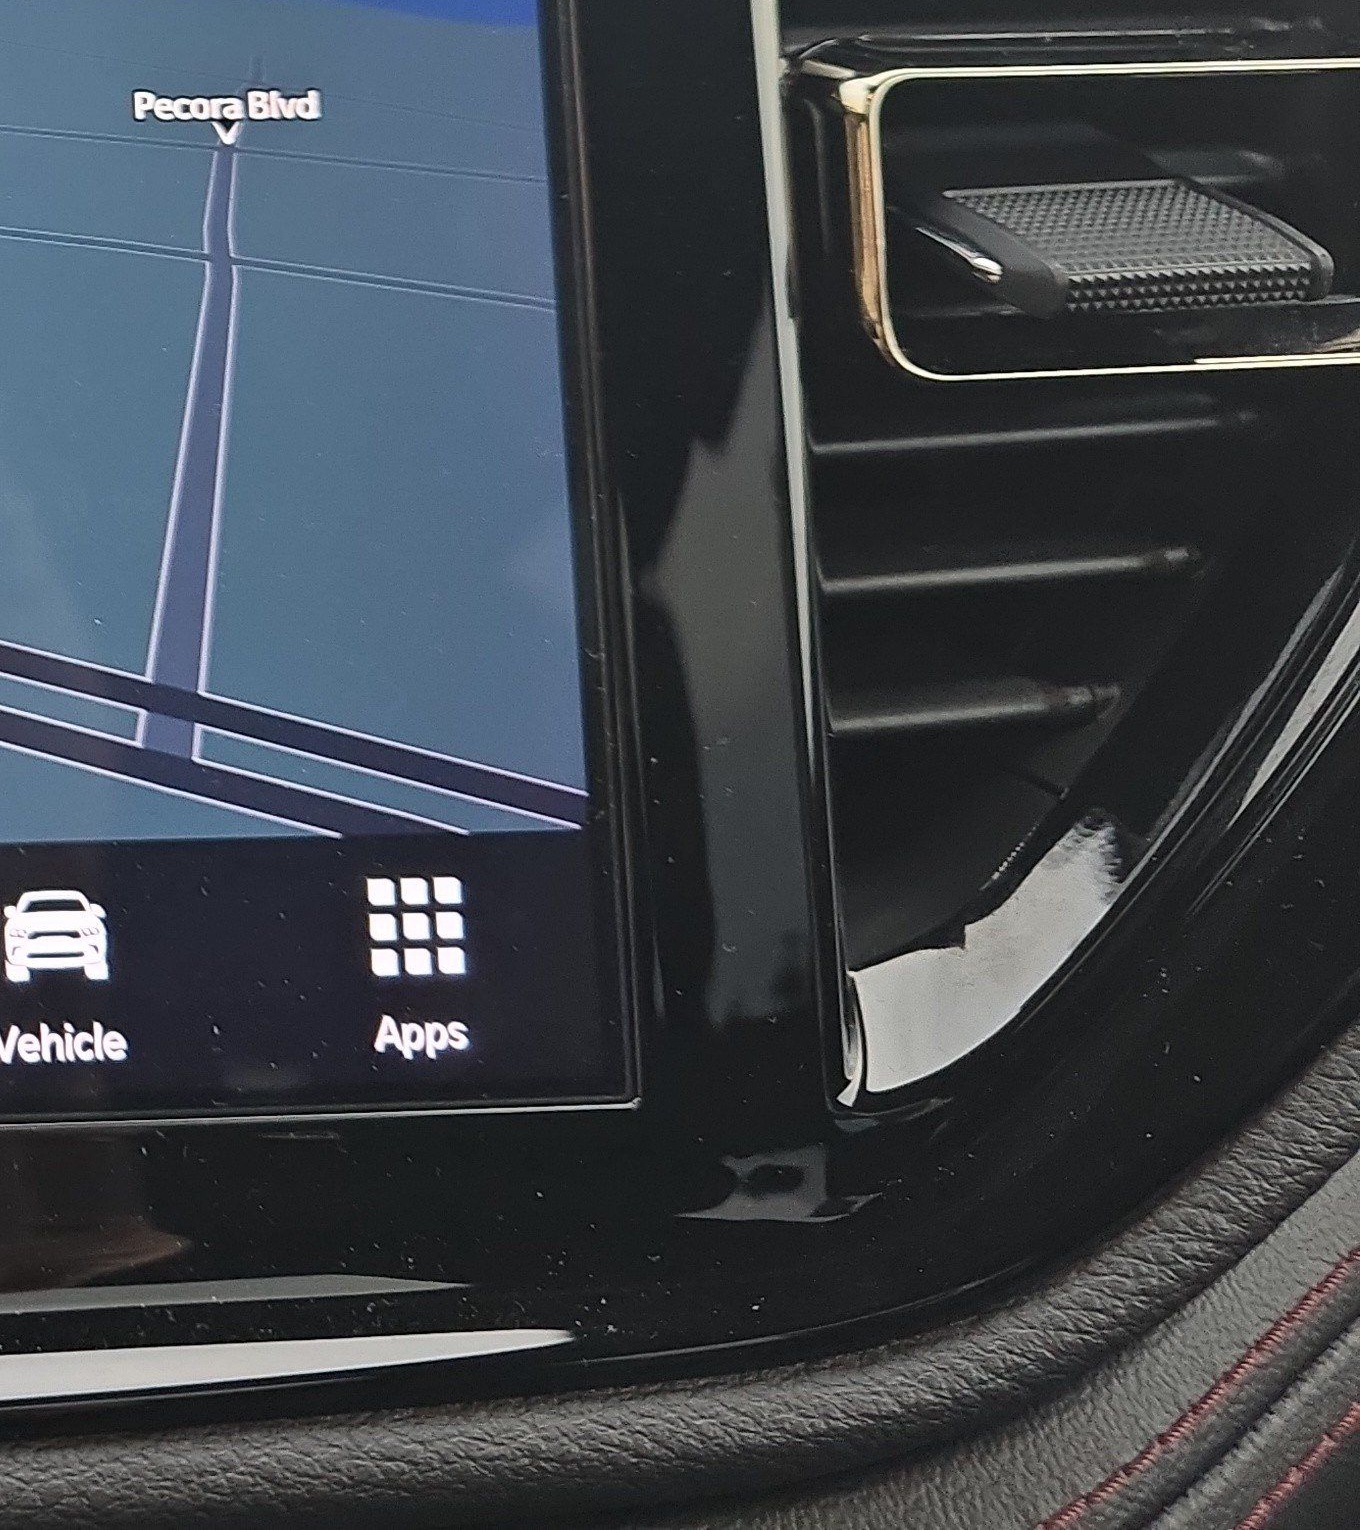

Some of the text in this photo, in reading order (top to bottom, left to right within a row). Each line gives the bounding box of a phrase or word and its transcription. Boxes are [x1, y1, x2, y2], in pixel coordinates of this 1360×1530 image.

[134, 91, 321, 121] Pecora Blvd
[374, 1016, 469, 1053] Apps
